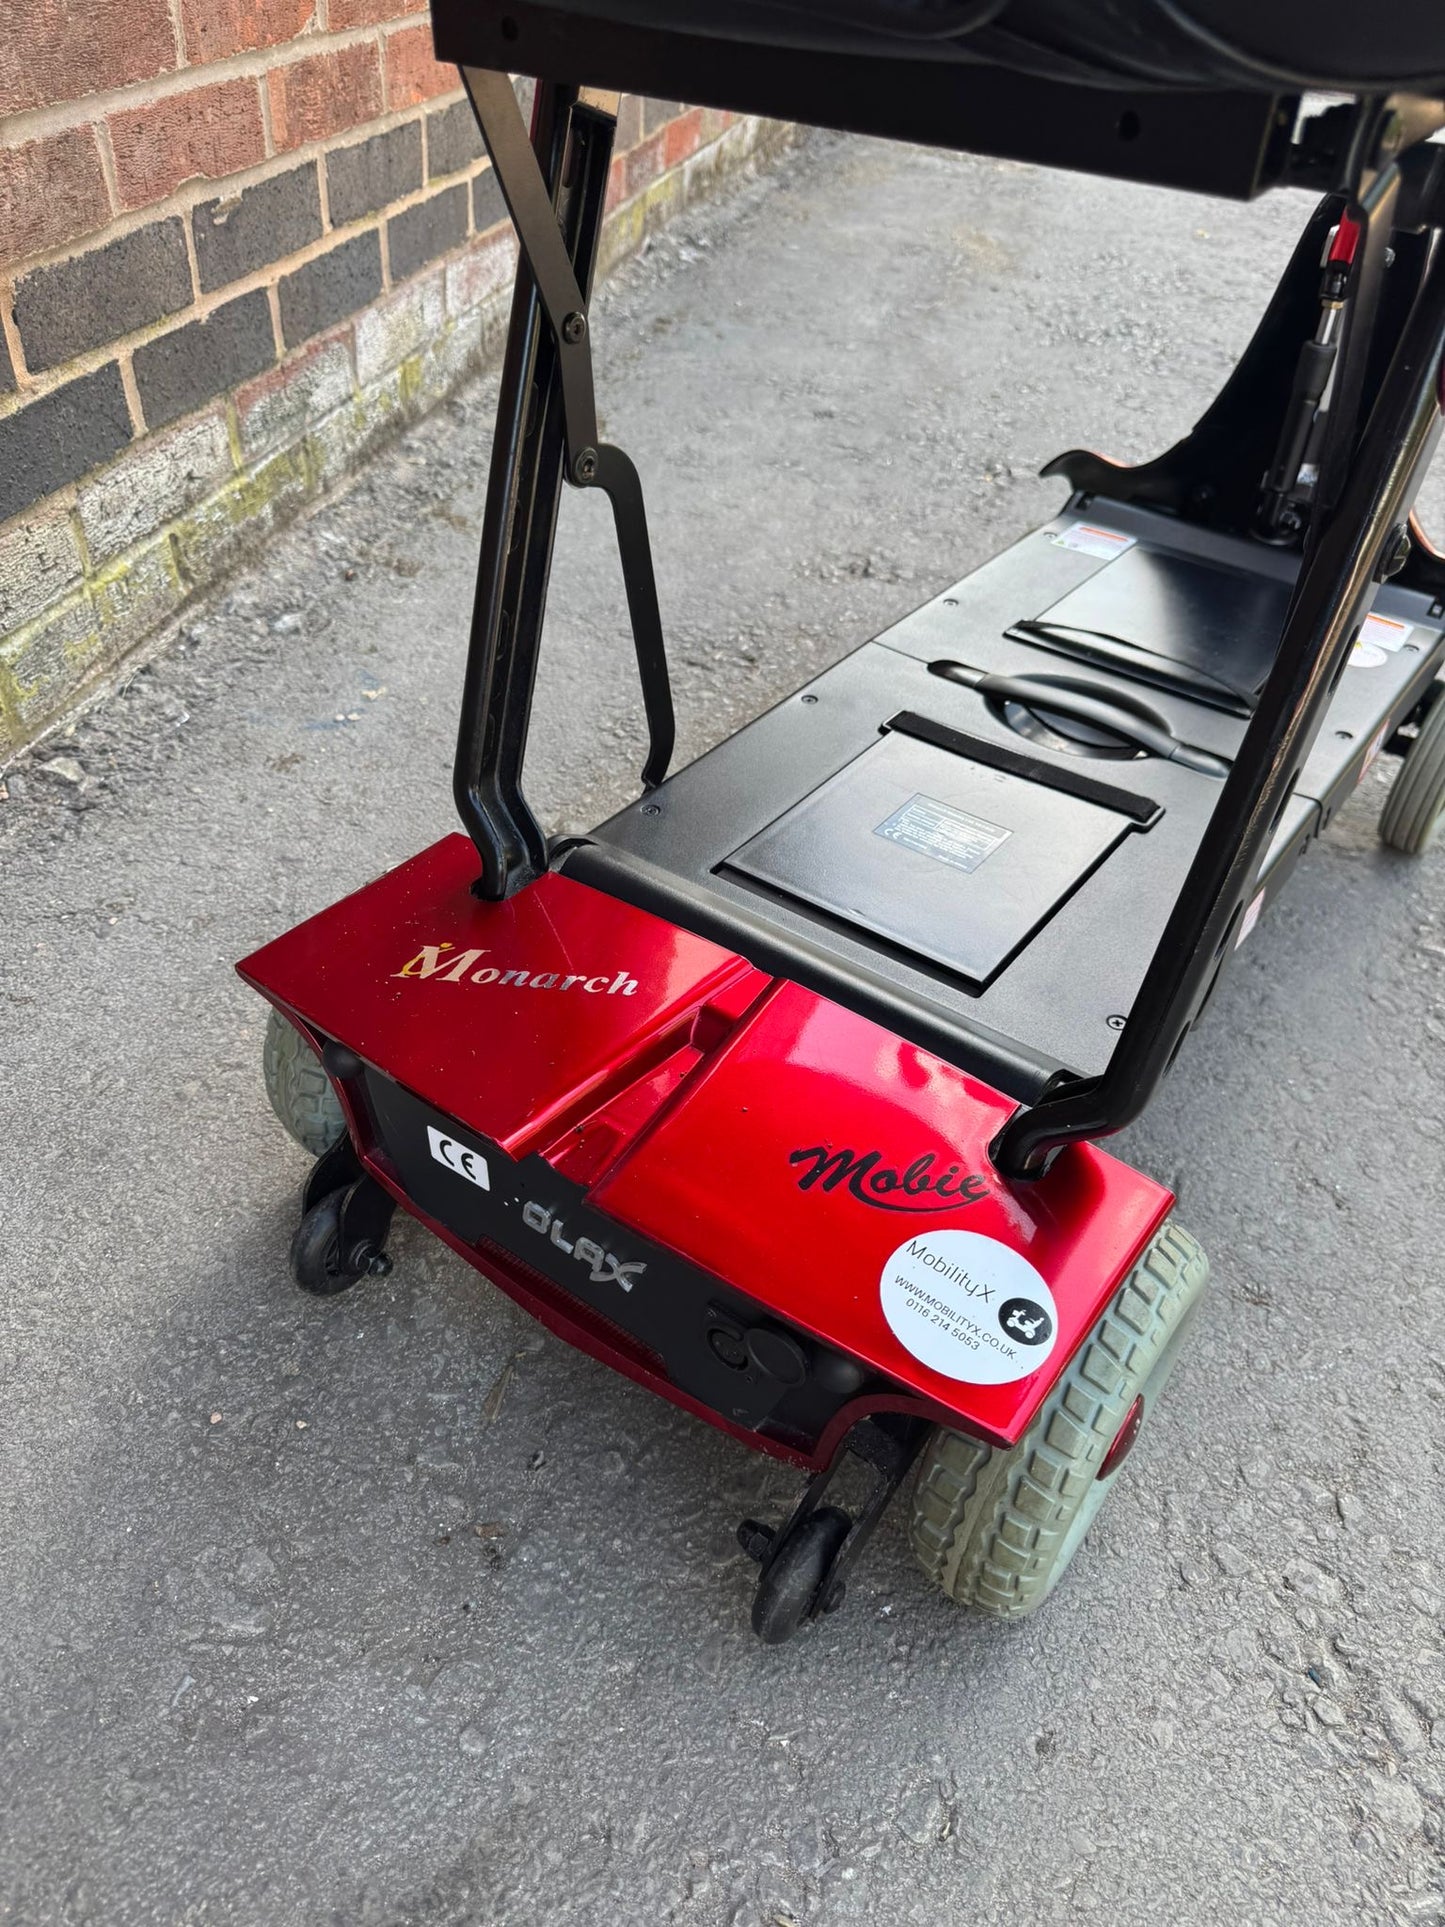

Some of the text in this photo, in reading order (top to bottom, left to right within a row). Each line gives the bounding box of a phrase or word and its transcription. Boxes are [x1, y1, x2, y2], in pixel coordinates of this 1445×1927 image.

[390, 943, 640, 996] Monarch
[439, 1139, 476, 1181] CE
[789, 1146, 991, 1213] Mobie
[905, 1240, 997, 1304] MobilityX
[905, 1298, 981, 1351] 0116 214 5053
